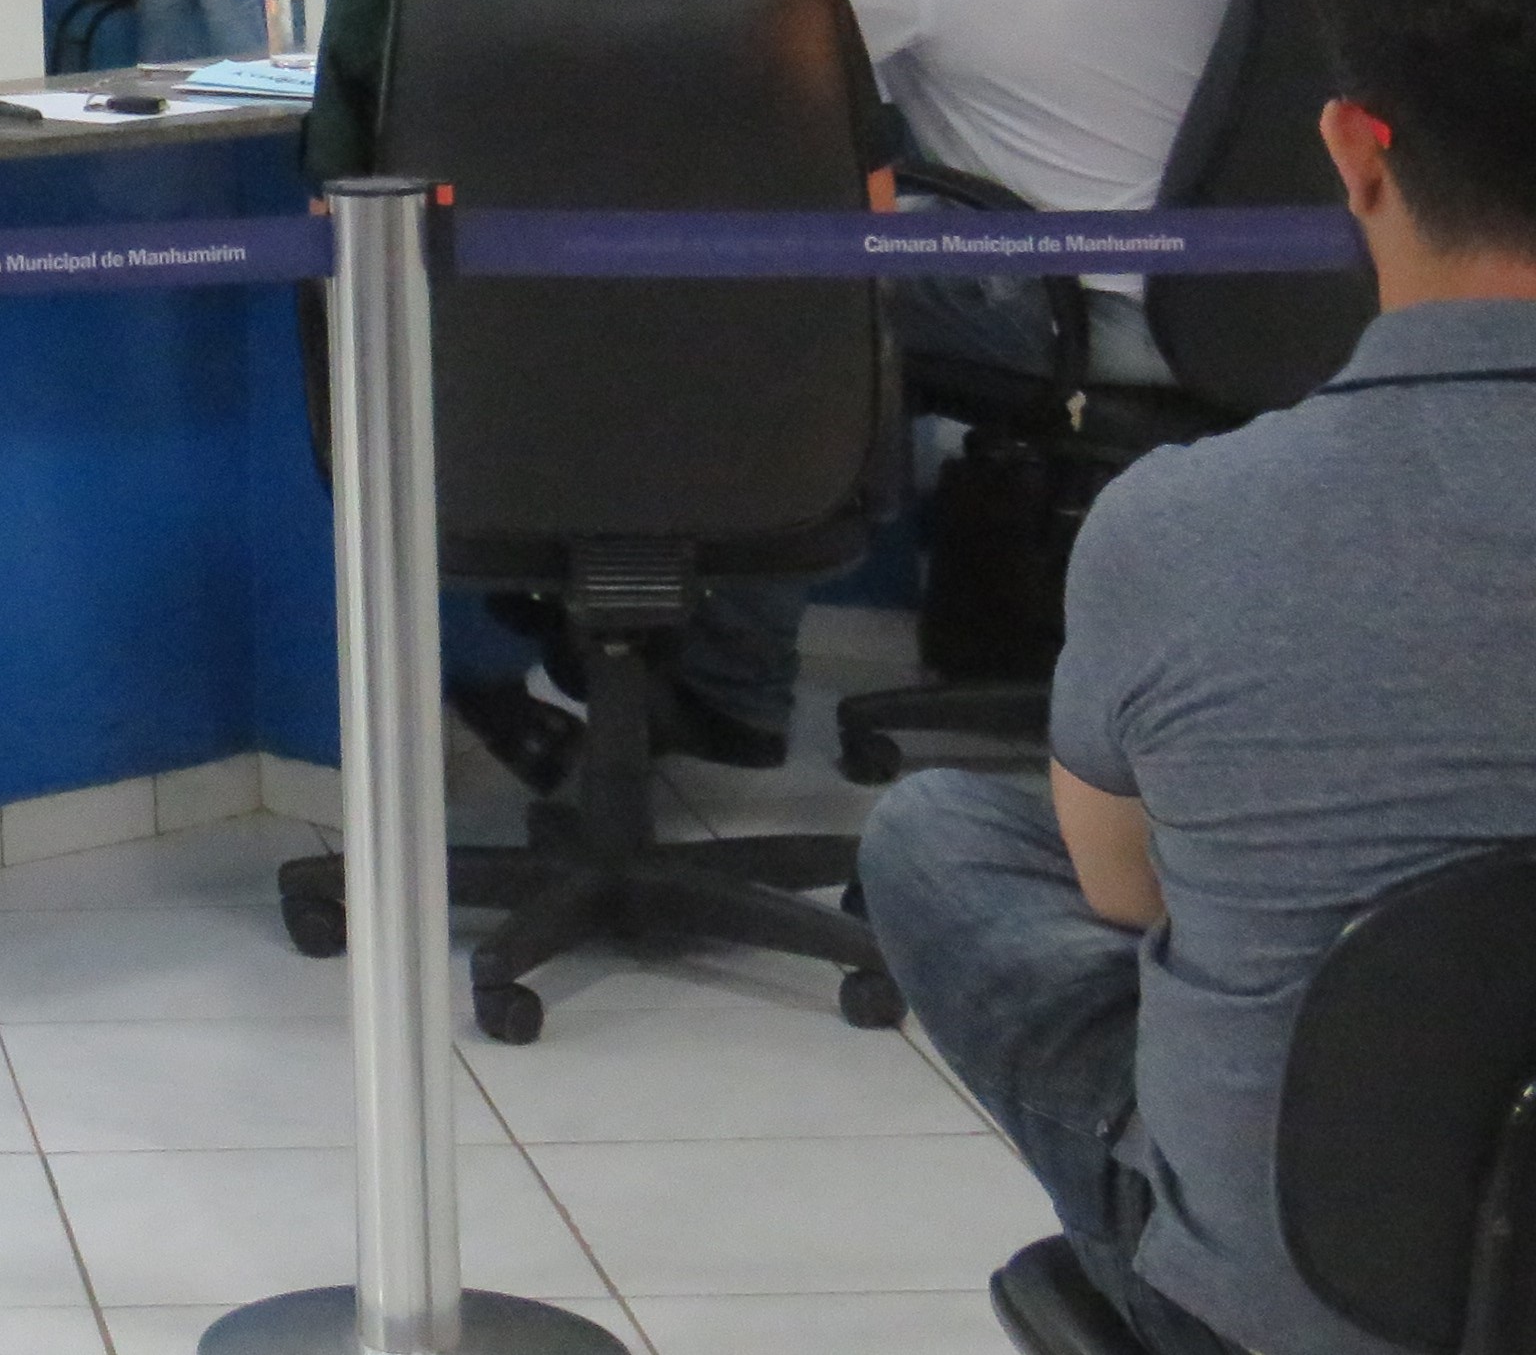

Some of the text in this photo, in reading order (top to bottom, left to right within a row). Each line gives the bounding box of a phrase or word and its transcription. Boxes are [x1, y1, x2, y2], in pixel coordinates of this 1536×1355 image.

[864, 233, 1185, 256] Câmara Municipal de Manhumirim
[6, 252, 96, 272] Municipal
[101, 251, 123, 268] de
[128, 245, 246, 266] Manhumirim
